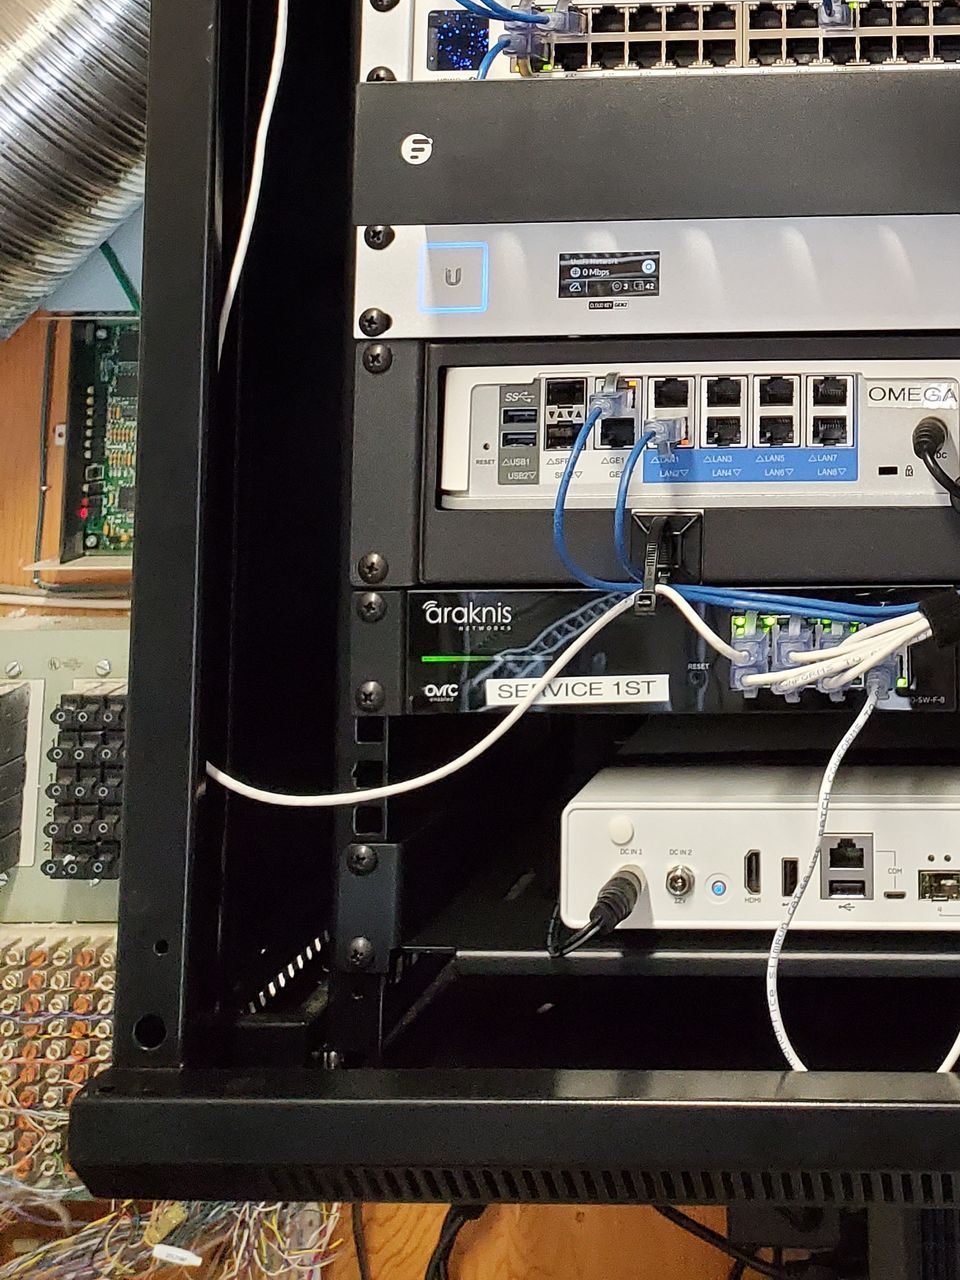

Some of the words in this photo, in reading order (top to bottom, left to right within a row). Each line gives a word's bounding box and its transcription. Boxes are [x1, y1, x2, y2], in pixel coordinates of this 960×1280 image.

[589, 269, 610, 277] Mbps
[868, 386, 958, 402] OMEGA
[712, 454, 732, 464] LAN3
[765, 454, 785, 463] LAN5
[817, 453, 838, 462] LAN7
[936, 451, 948, 459] DC
[510, 457, 530, 466] USB1
[609, 456, 625, 464] GE1
[508, 471, 530, 480] USB2
[712, 468, 732, 477] LAN4
[424, 601, 512, 624] araknis
[612, 680, 656, 696] 1ST
